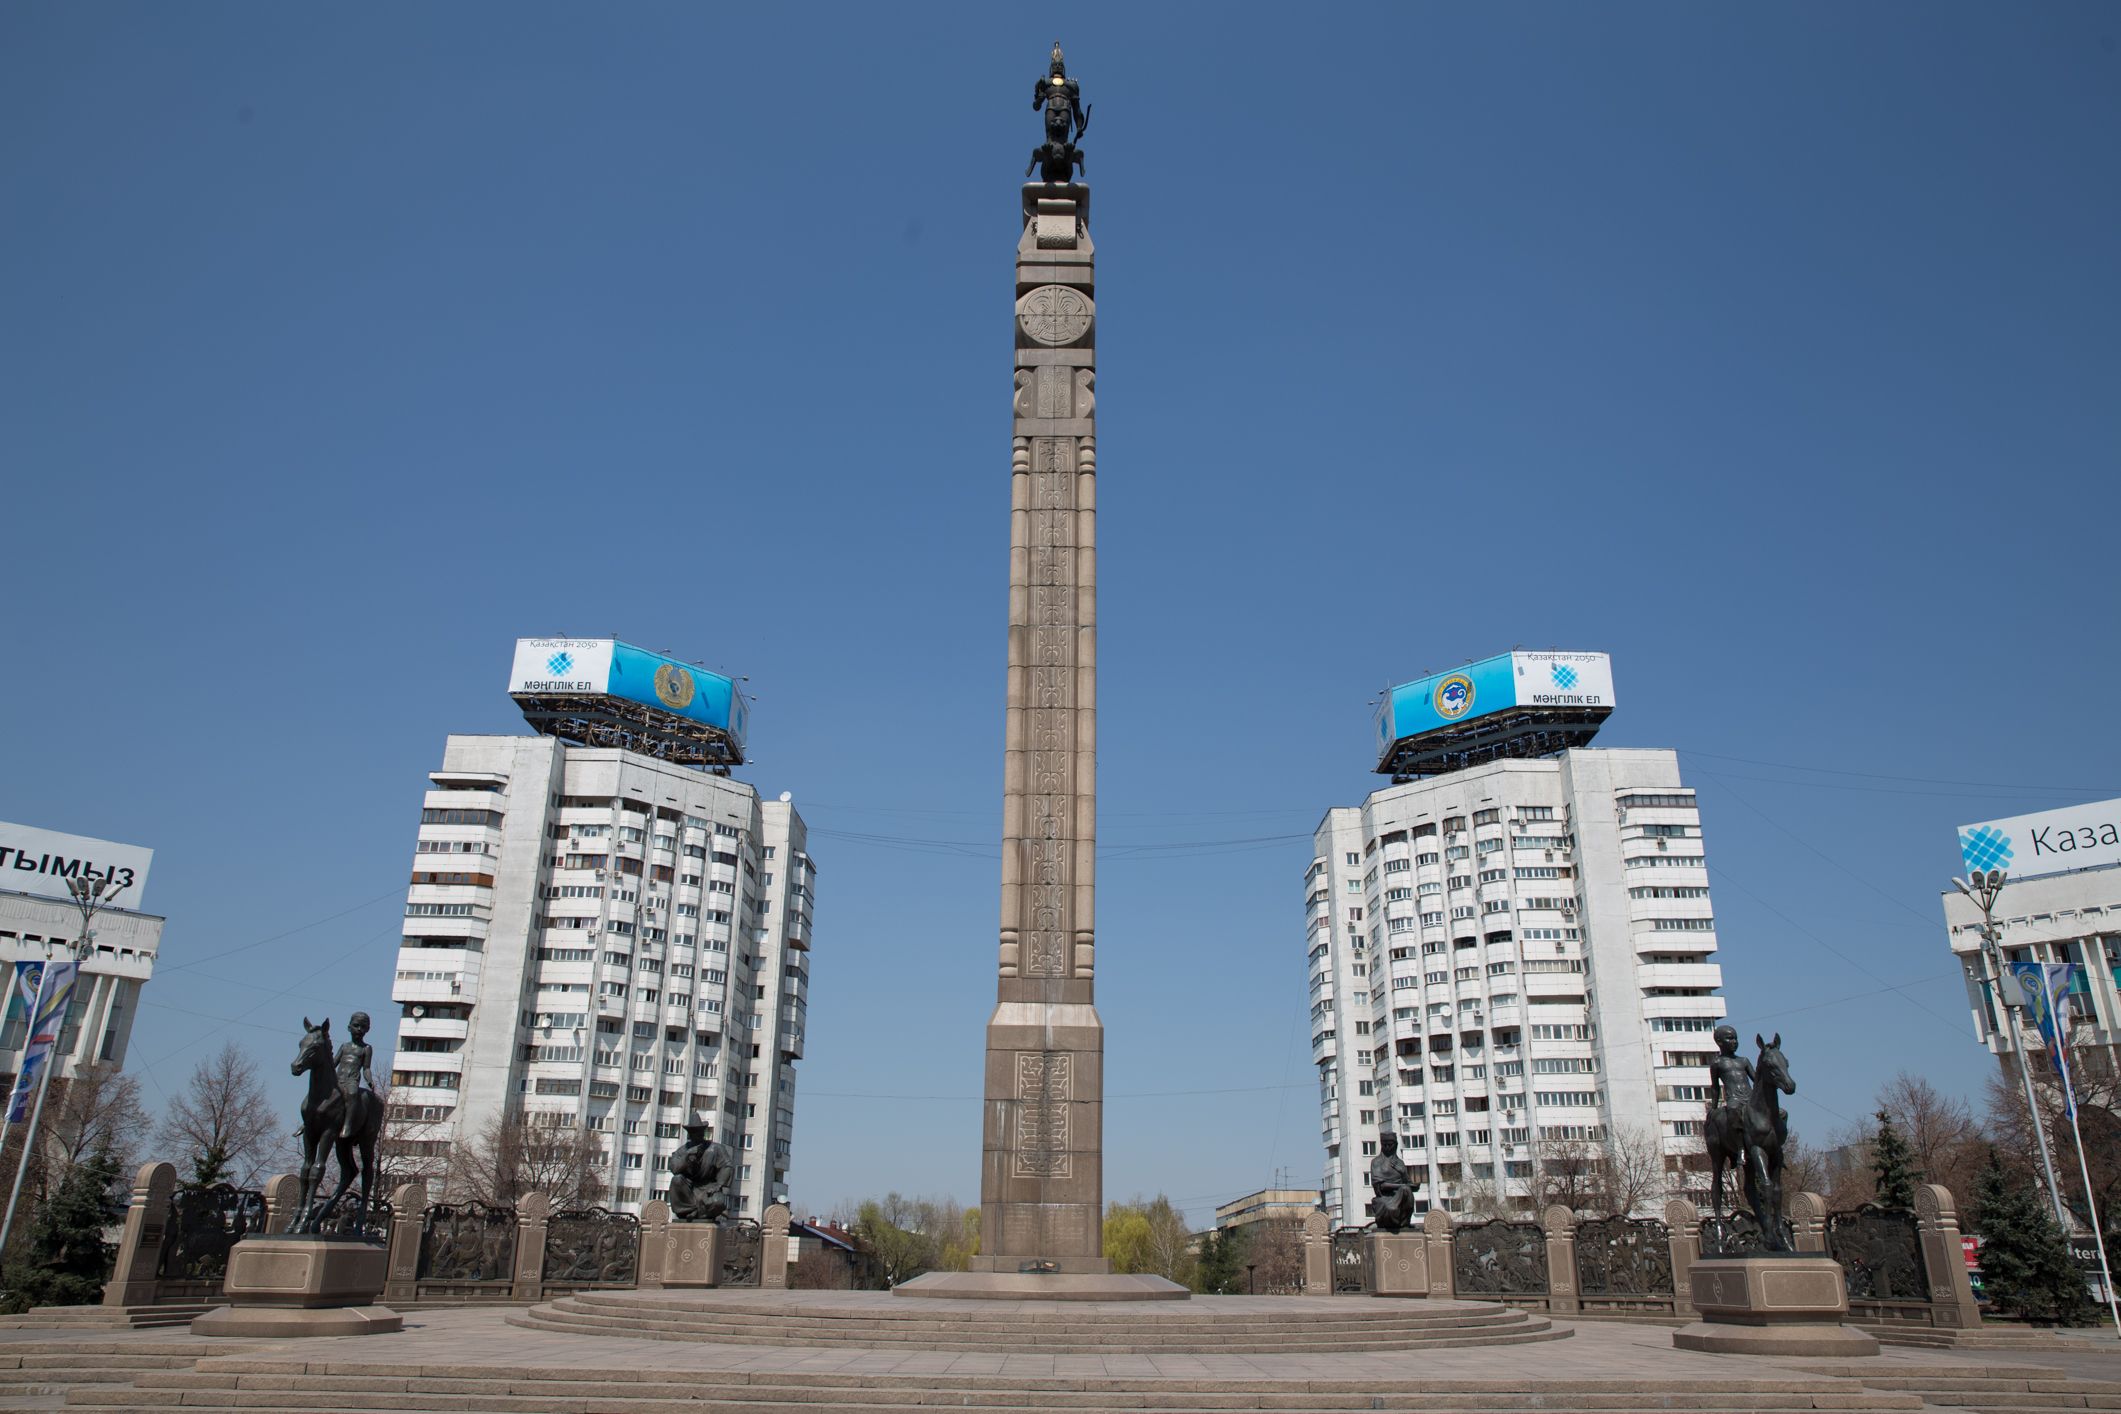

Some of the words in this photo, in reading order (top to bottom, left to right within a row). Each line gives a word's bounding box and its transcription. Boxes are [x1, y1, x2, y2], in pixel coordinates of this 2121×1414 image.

[1574, 655, 1596, 663] 2050
[524, 681, 574, 691] МӘҢГІЛІК
[577, 681, 592, 690] ЕЛ
[1533, 694, 1583, 704] МӘҢГІЛІК
[1586, 695, 1600, 704] ЕЛ
